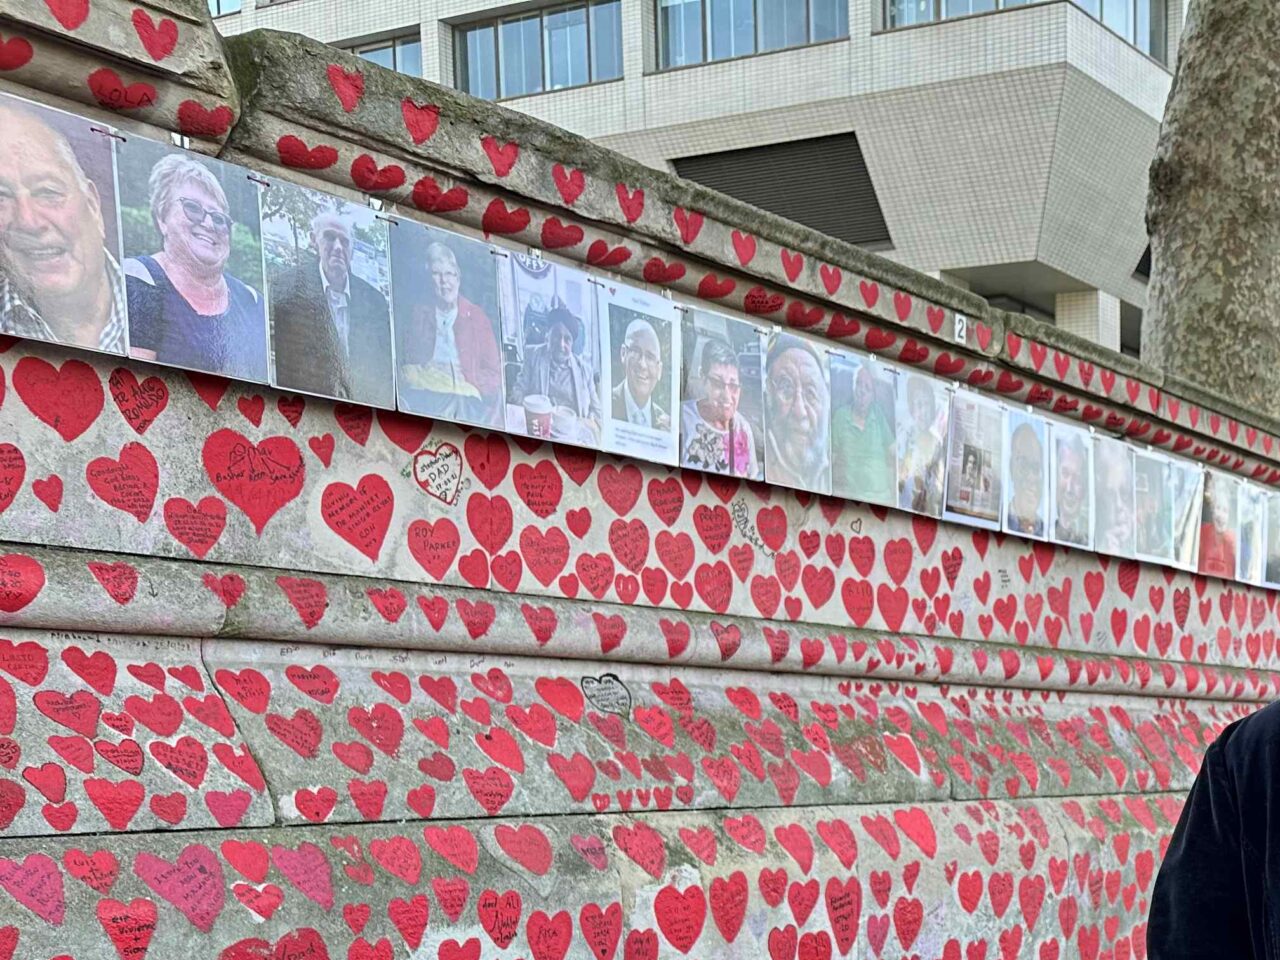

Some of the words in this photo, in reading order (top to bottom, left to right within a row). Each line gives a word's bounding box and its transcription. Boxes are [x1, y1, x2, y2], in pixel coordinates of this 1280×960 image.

[96, 86, 154, 106] LOLA
[957, 318, 965, 339] 2
[428, 463, 450, 483] DAD
[414, 527, 436, 539] ROY
[423, 540, 458, 551] PARKER
